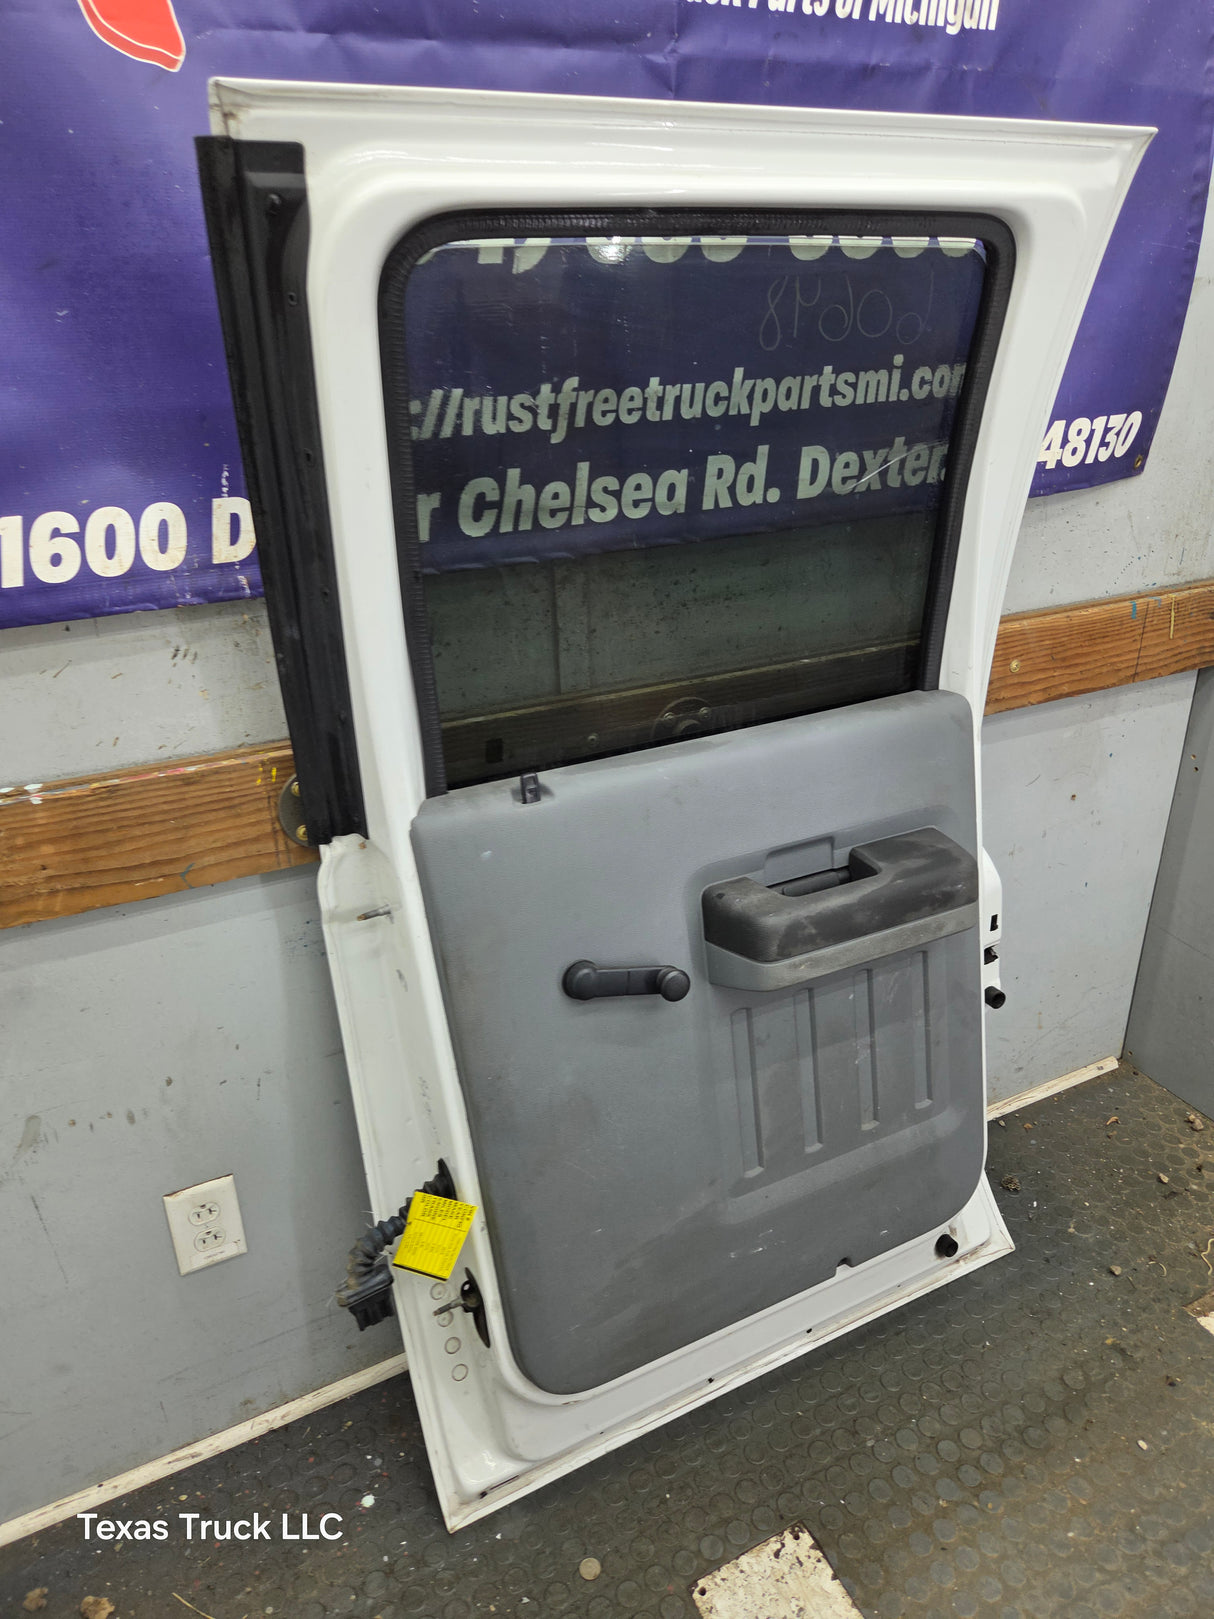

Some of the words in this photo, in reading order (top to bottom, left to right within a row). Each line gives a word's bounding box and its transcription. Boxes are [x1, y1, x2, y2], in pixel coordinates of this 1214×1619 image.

[457, 461, 688, 537] Chelsea
[702, 445, 780, 510] Rd.
[1036, 410, 1142, 470] 48130
